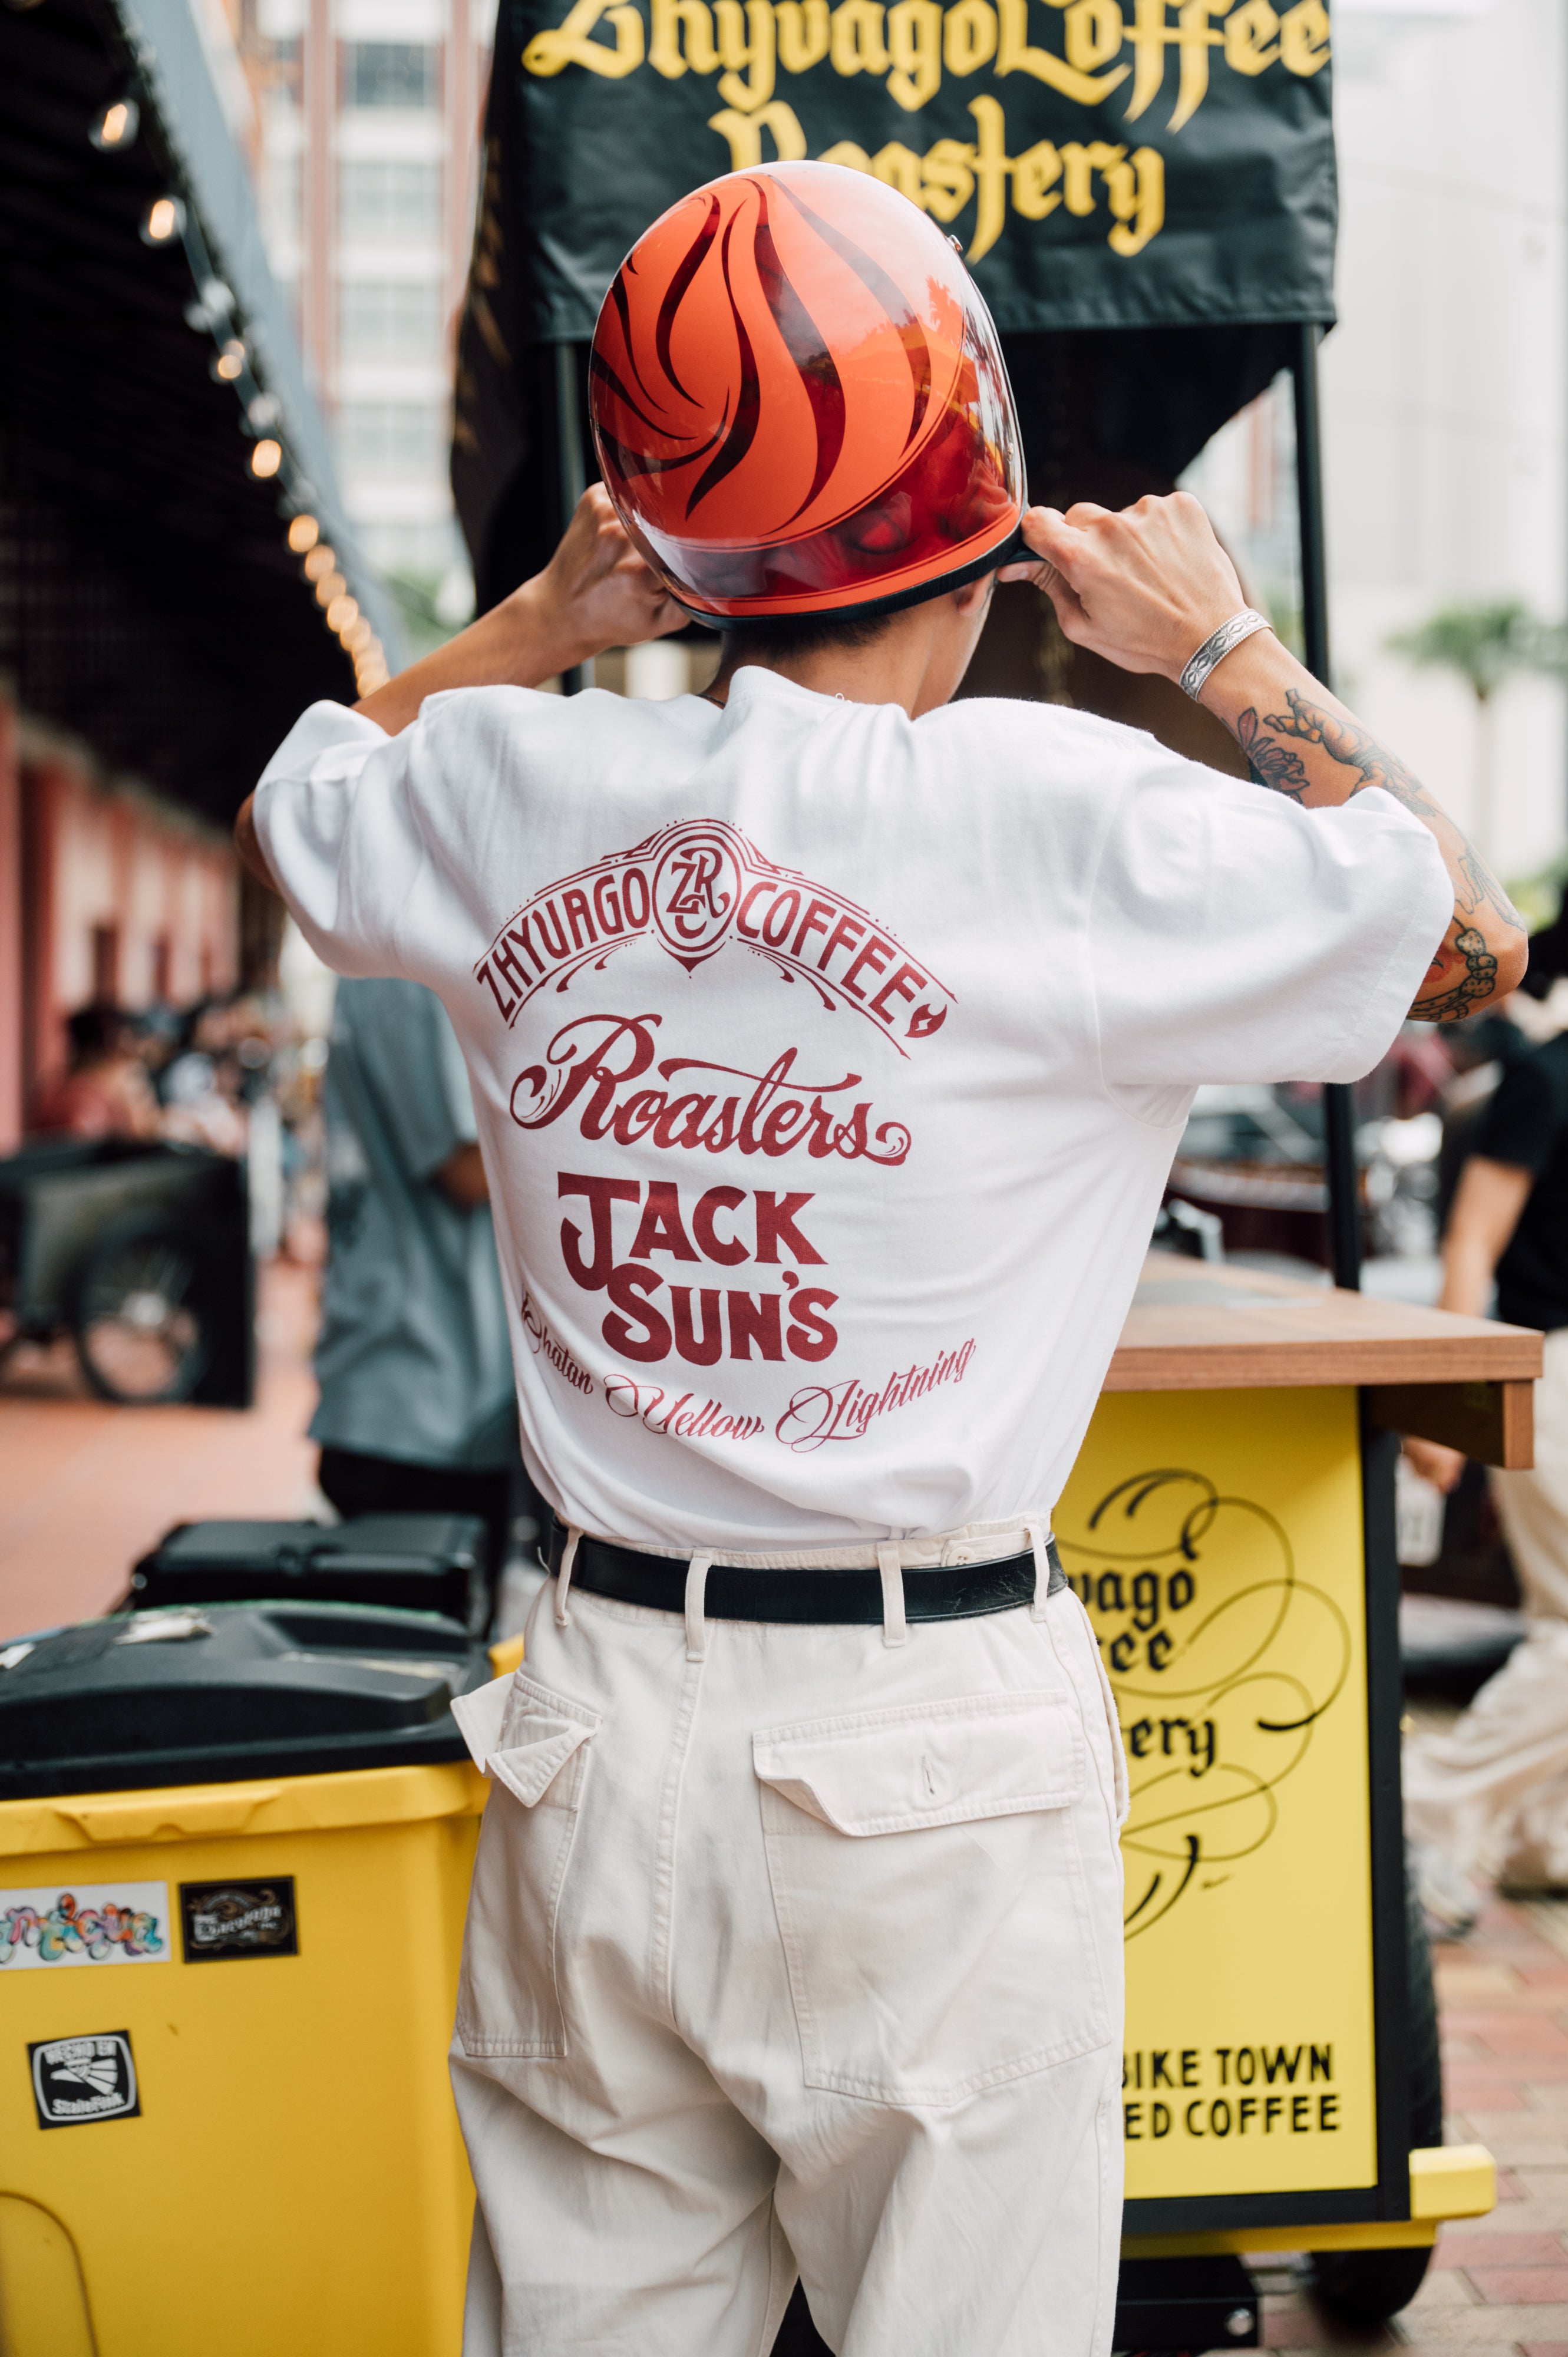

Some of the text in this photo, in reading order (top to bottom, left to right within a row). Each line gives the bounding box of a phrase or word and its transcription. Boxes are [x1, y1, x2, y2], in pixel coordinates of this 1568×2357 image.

[735, 881, 928, 1025] COFFEE
[510, 1013, 912, 1166] Roasters
[557, 1171, 829, 1291] JACK
[603, 1374, 765, 1441] Yellow
[775, 1338, 976, 1453] Lightning
[1095, 1629, 1174, 1672] ee
[1121, 1716, 1216, 1777] ery
[1216, 2043, 1331, 2086] TOWN
[1186, 2094, 1338, 2137] COFFEE
